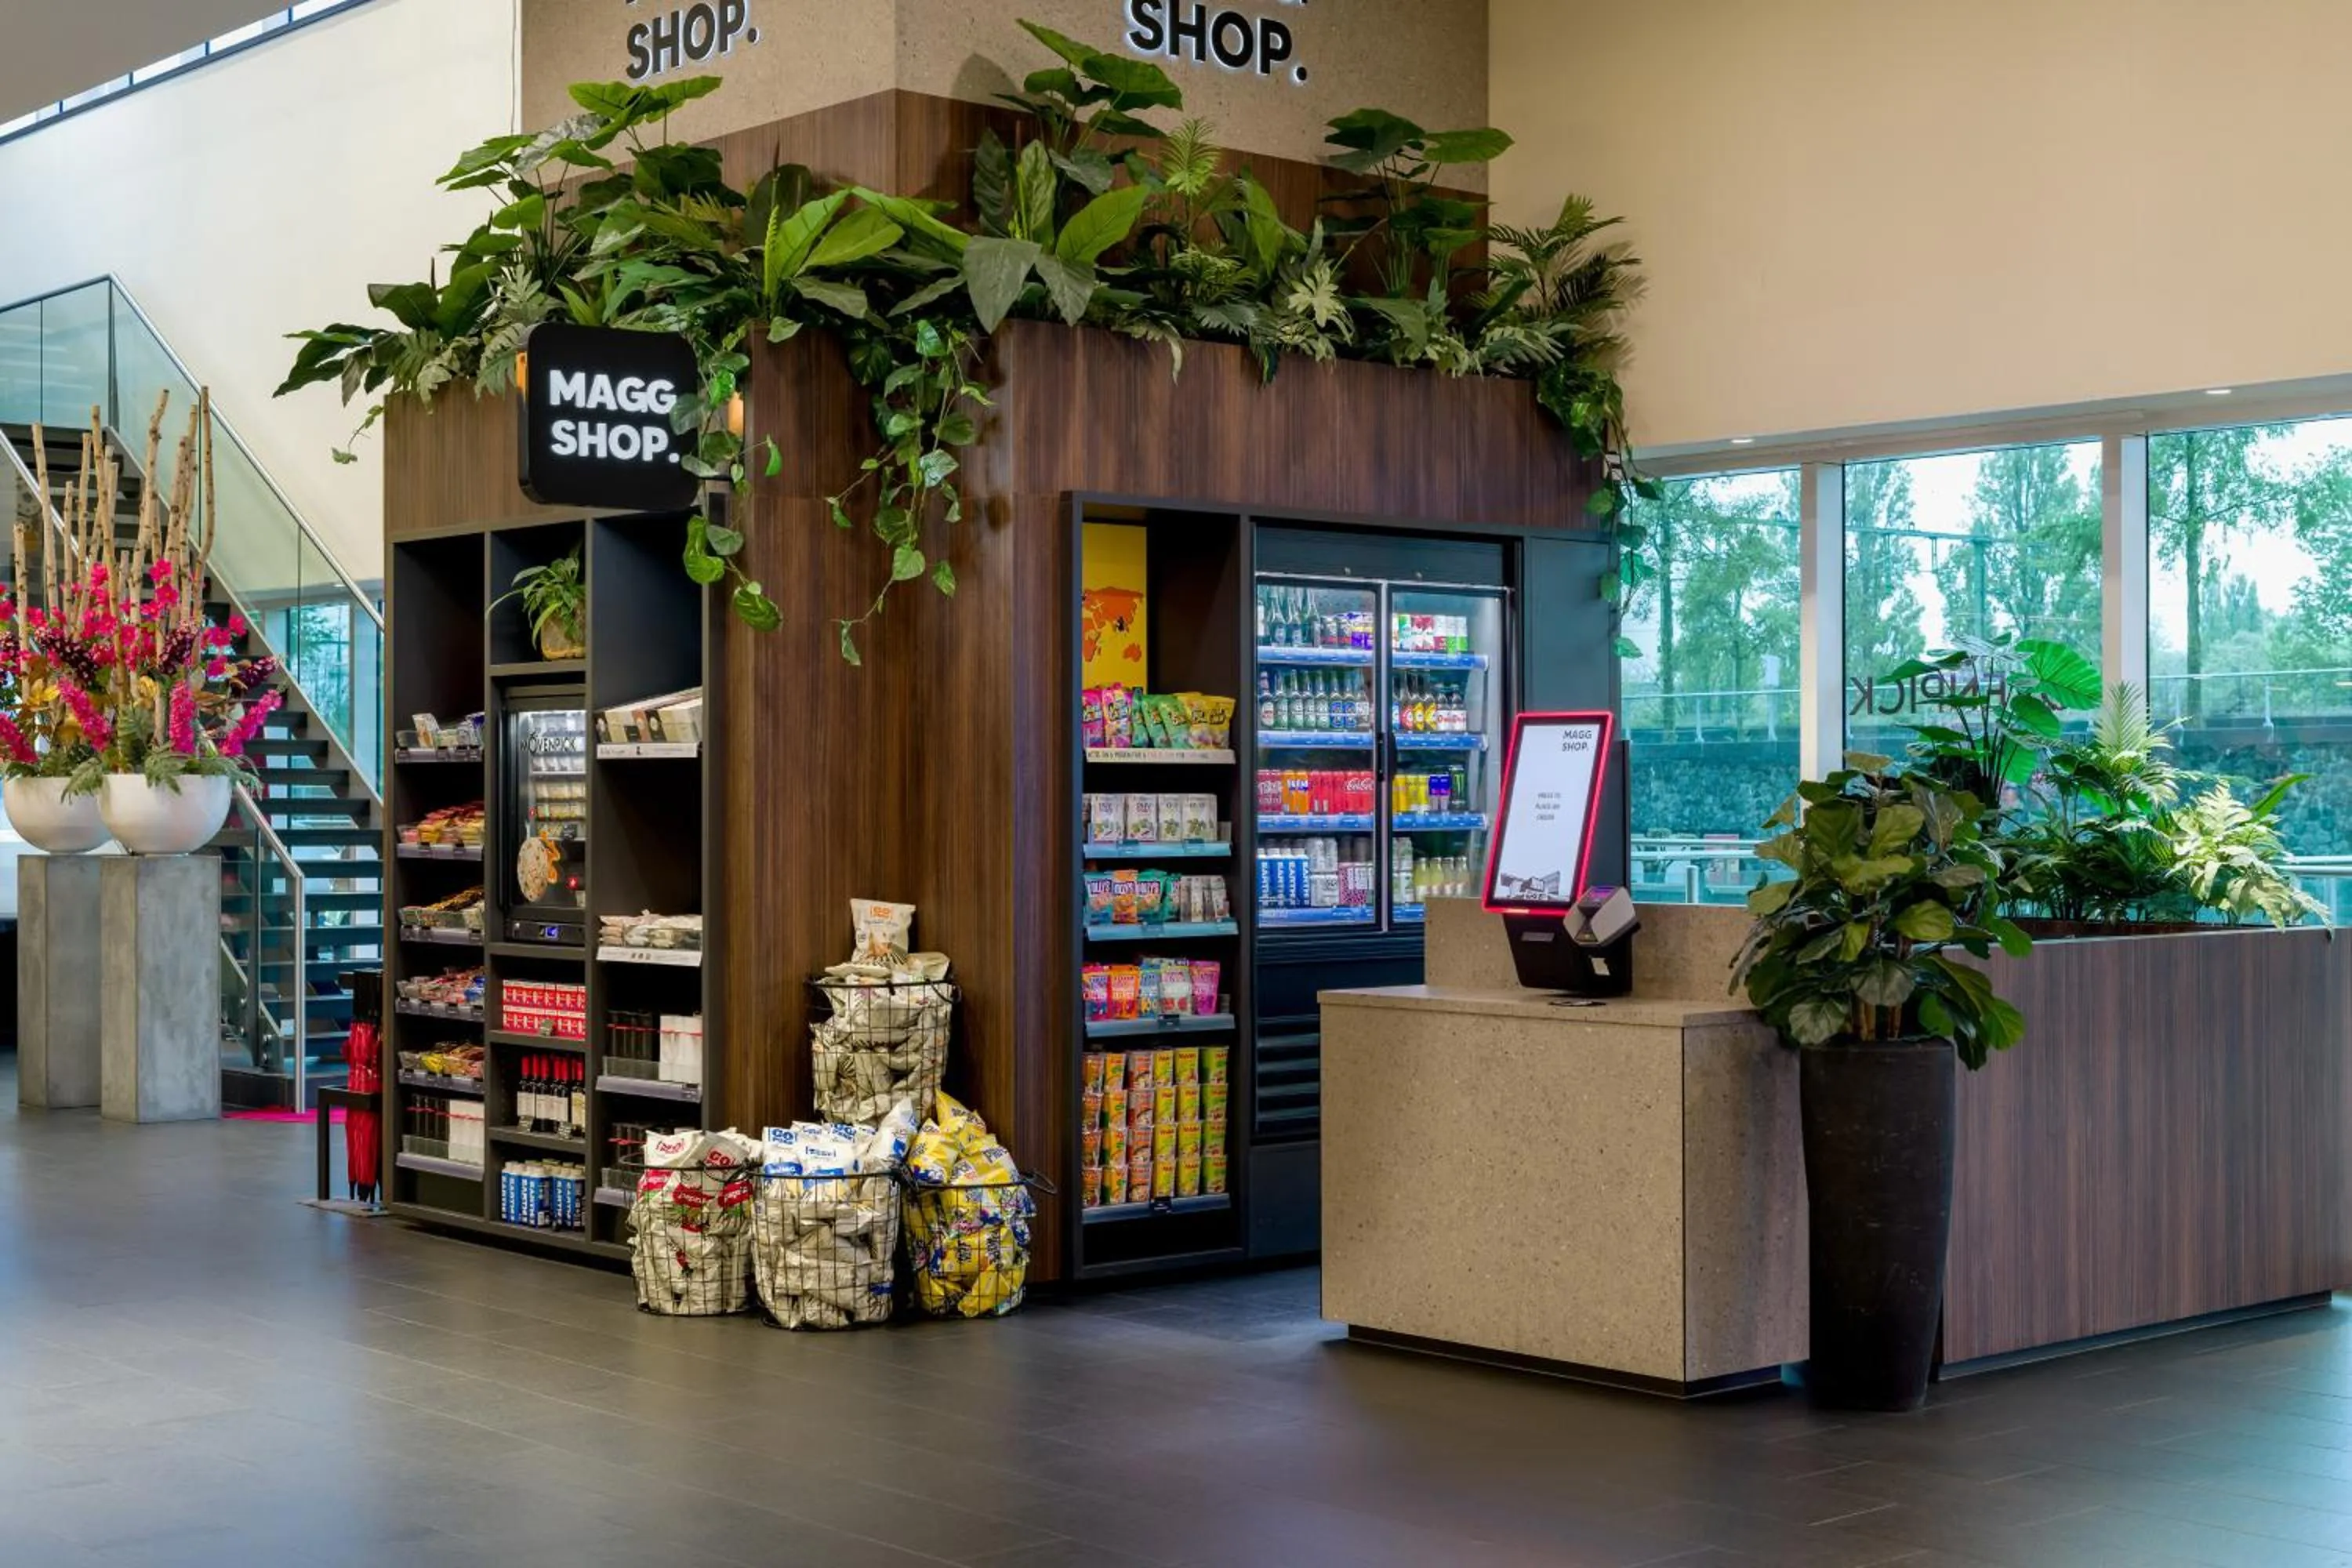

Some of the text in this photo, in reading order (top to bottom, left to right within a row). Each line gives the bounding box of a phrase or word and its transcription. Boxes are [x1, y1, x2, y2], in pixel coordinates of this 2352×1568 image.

[626, 0, 759, 79] SHOP.
[1128, 0, 1307, 81] SHOP.
[550, 369, 677, 415] MAGG
[551, 419, 680, 463] SHOP.
[1562, 741, 1589, 752] SHOP.
[1563, 730, 1592, 739] MAGG
